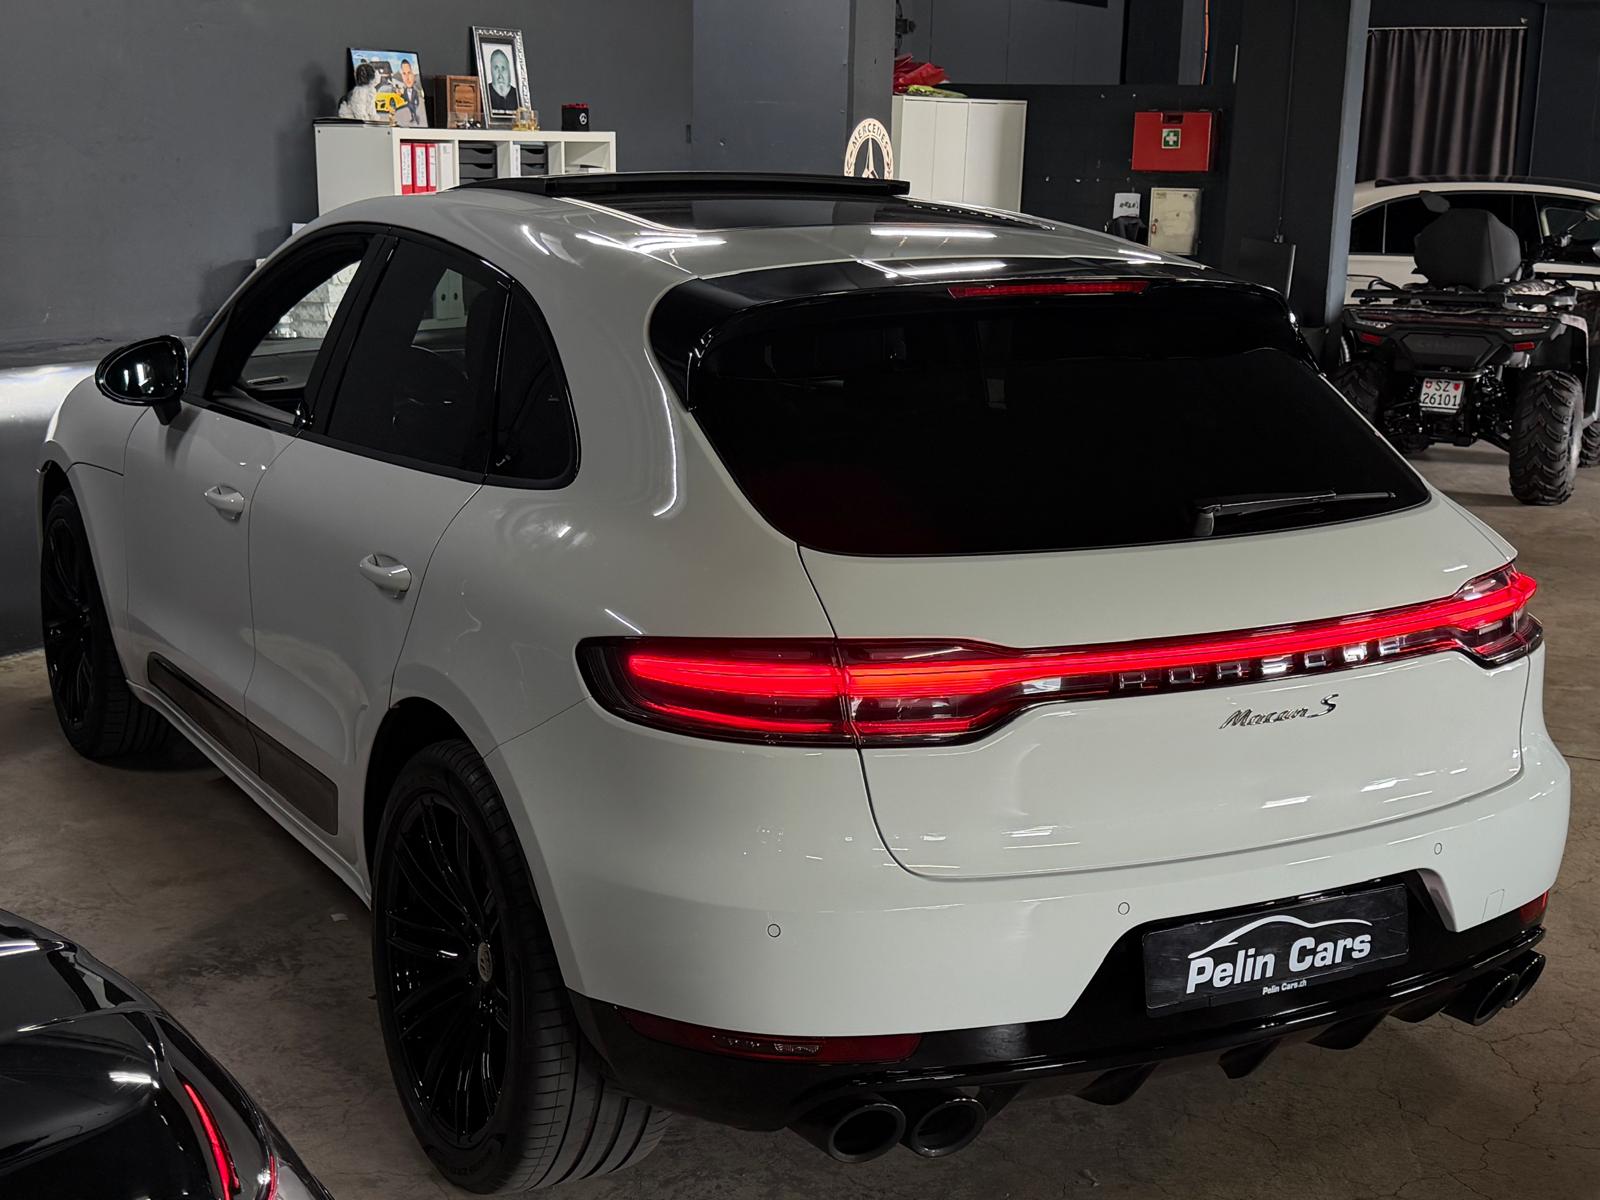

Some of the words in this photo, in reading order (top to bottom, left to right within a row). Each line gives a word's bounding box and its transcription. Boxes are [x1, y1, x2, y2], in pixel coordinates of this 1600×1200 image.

[851, 122, 889, 149] MERCEDES
[1434, 380, 1451, 392] SZ
[1422, 392, 1458, 406] 26101
[1218, 708, 1309, 730] Macan
[1307, 693, 1339, 719] S
[1186, 948, 1276, 994] Pelin
[1288, 934, 1372, 973] Cars
[1262, 984, 1280, 996] Pelin
[1281, 979, 1307, 991] Cars.ch
